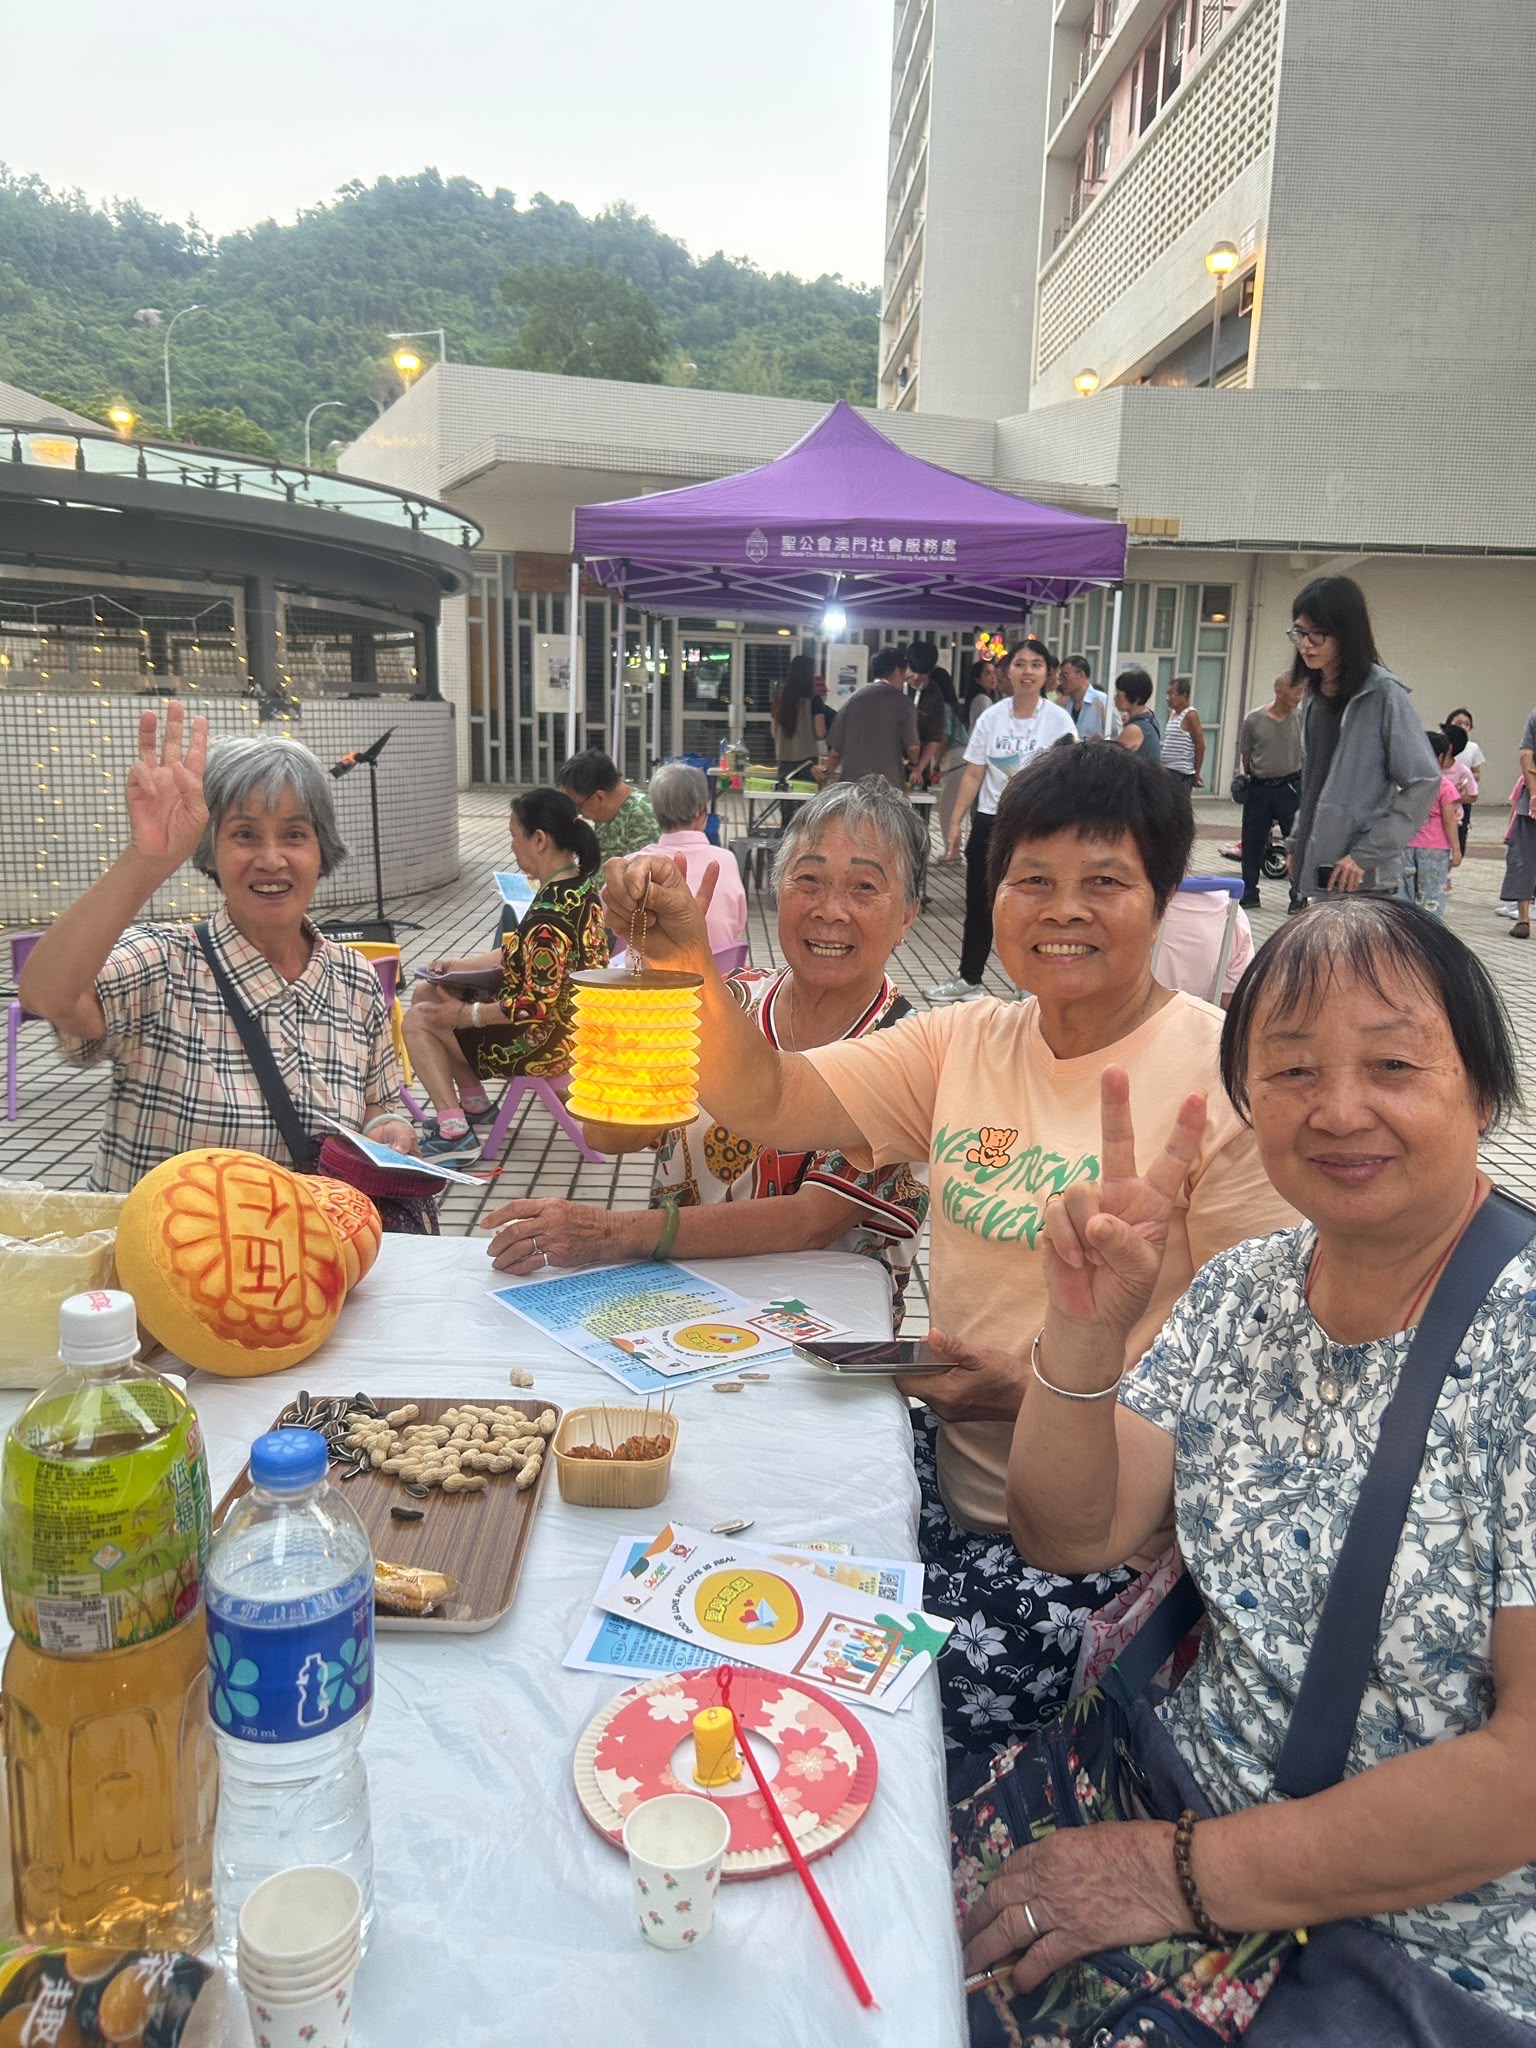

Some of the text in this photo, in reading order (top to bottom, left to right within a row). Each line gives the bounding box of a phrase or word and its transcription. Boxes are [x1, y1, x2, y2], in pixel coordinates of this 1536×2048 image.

[781, 535, 957, 555] 聖公會澳門社會服務處
[942, 1176, 1044, 1251] HEAVEN
[171, 1458, 194, 1537] 低糖
[702, 1563, 712, 1571] IS
[714, 1556, 736, 1567] REAL
[684, 1569, 703, 1584] LOVE
[675, 1584, 686, 1598] AND
[672, 1599, 680, 1614] LOVE
